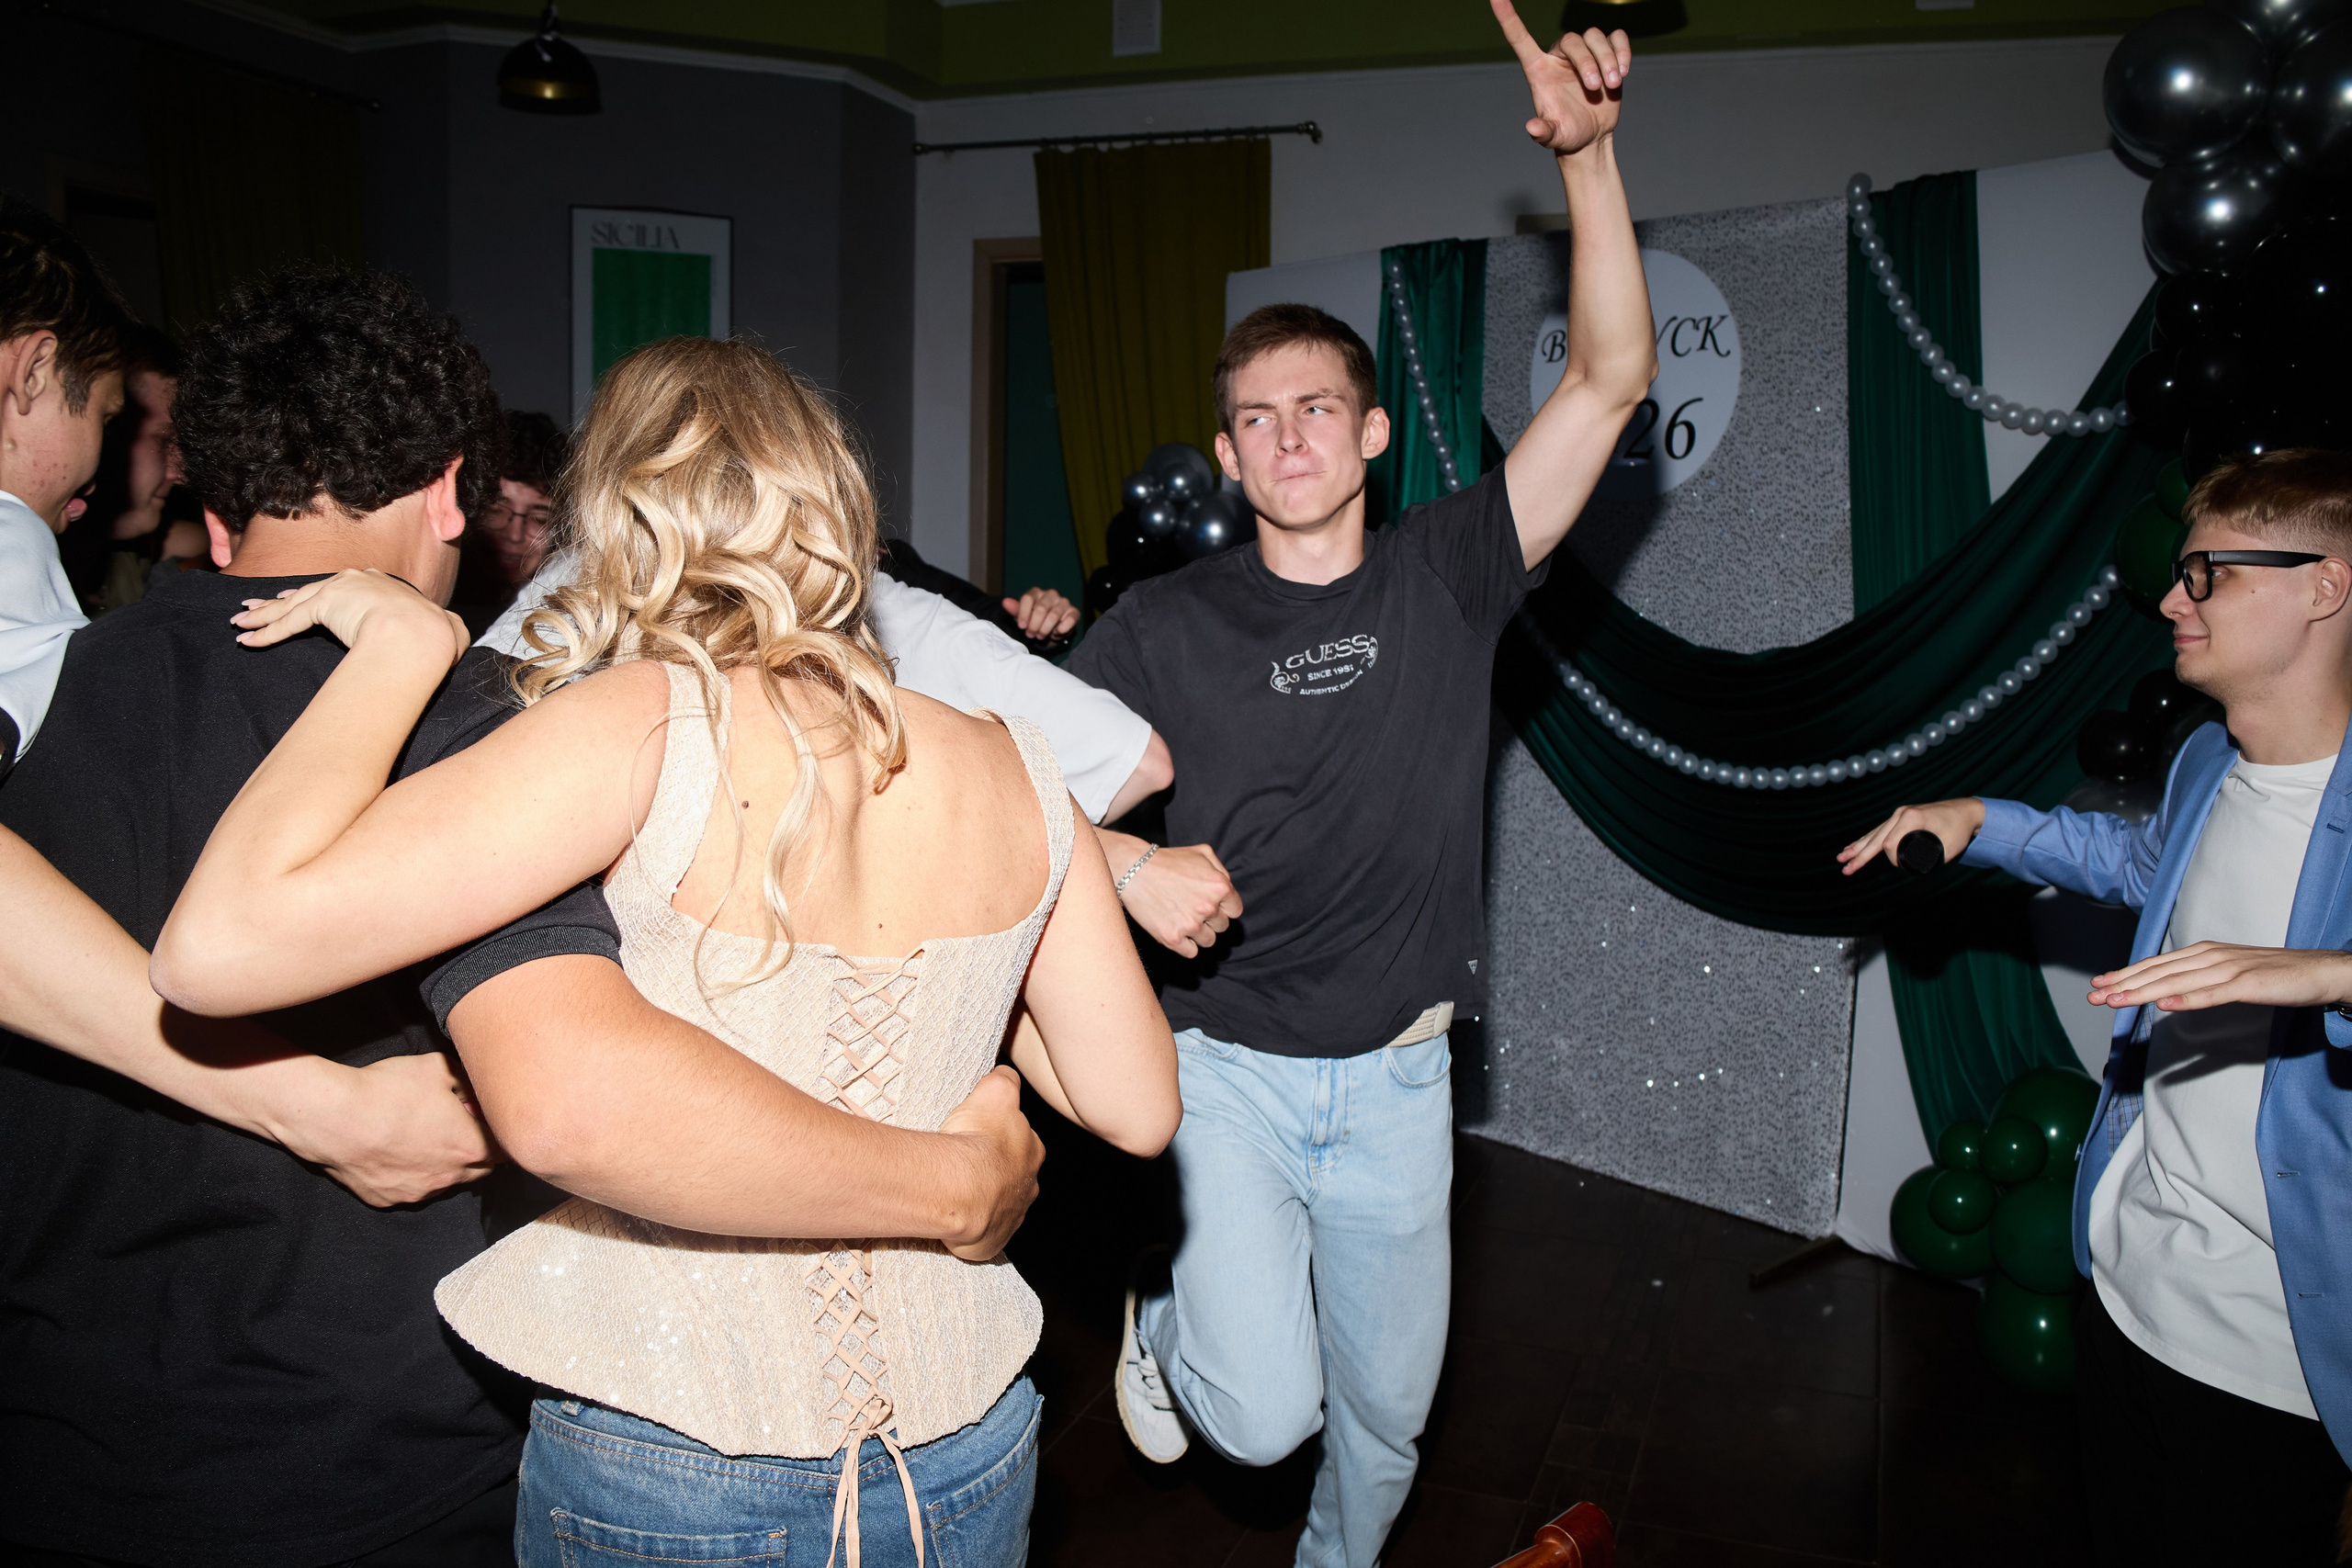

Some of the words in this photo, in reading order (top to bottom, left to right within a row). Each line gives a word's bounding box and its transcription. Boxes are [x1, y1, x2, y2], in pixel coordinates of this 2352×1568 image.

[590, 220, 680, 250] SICILIA
[1285, 634, 1370, 669] GUESS
[1306, 668, 1332, 682] SINCE
[1299, 684, 1340, 695] AUTHENTIC
